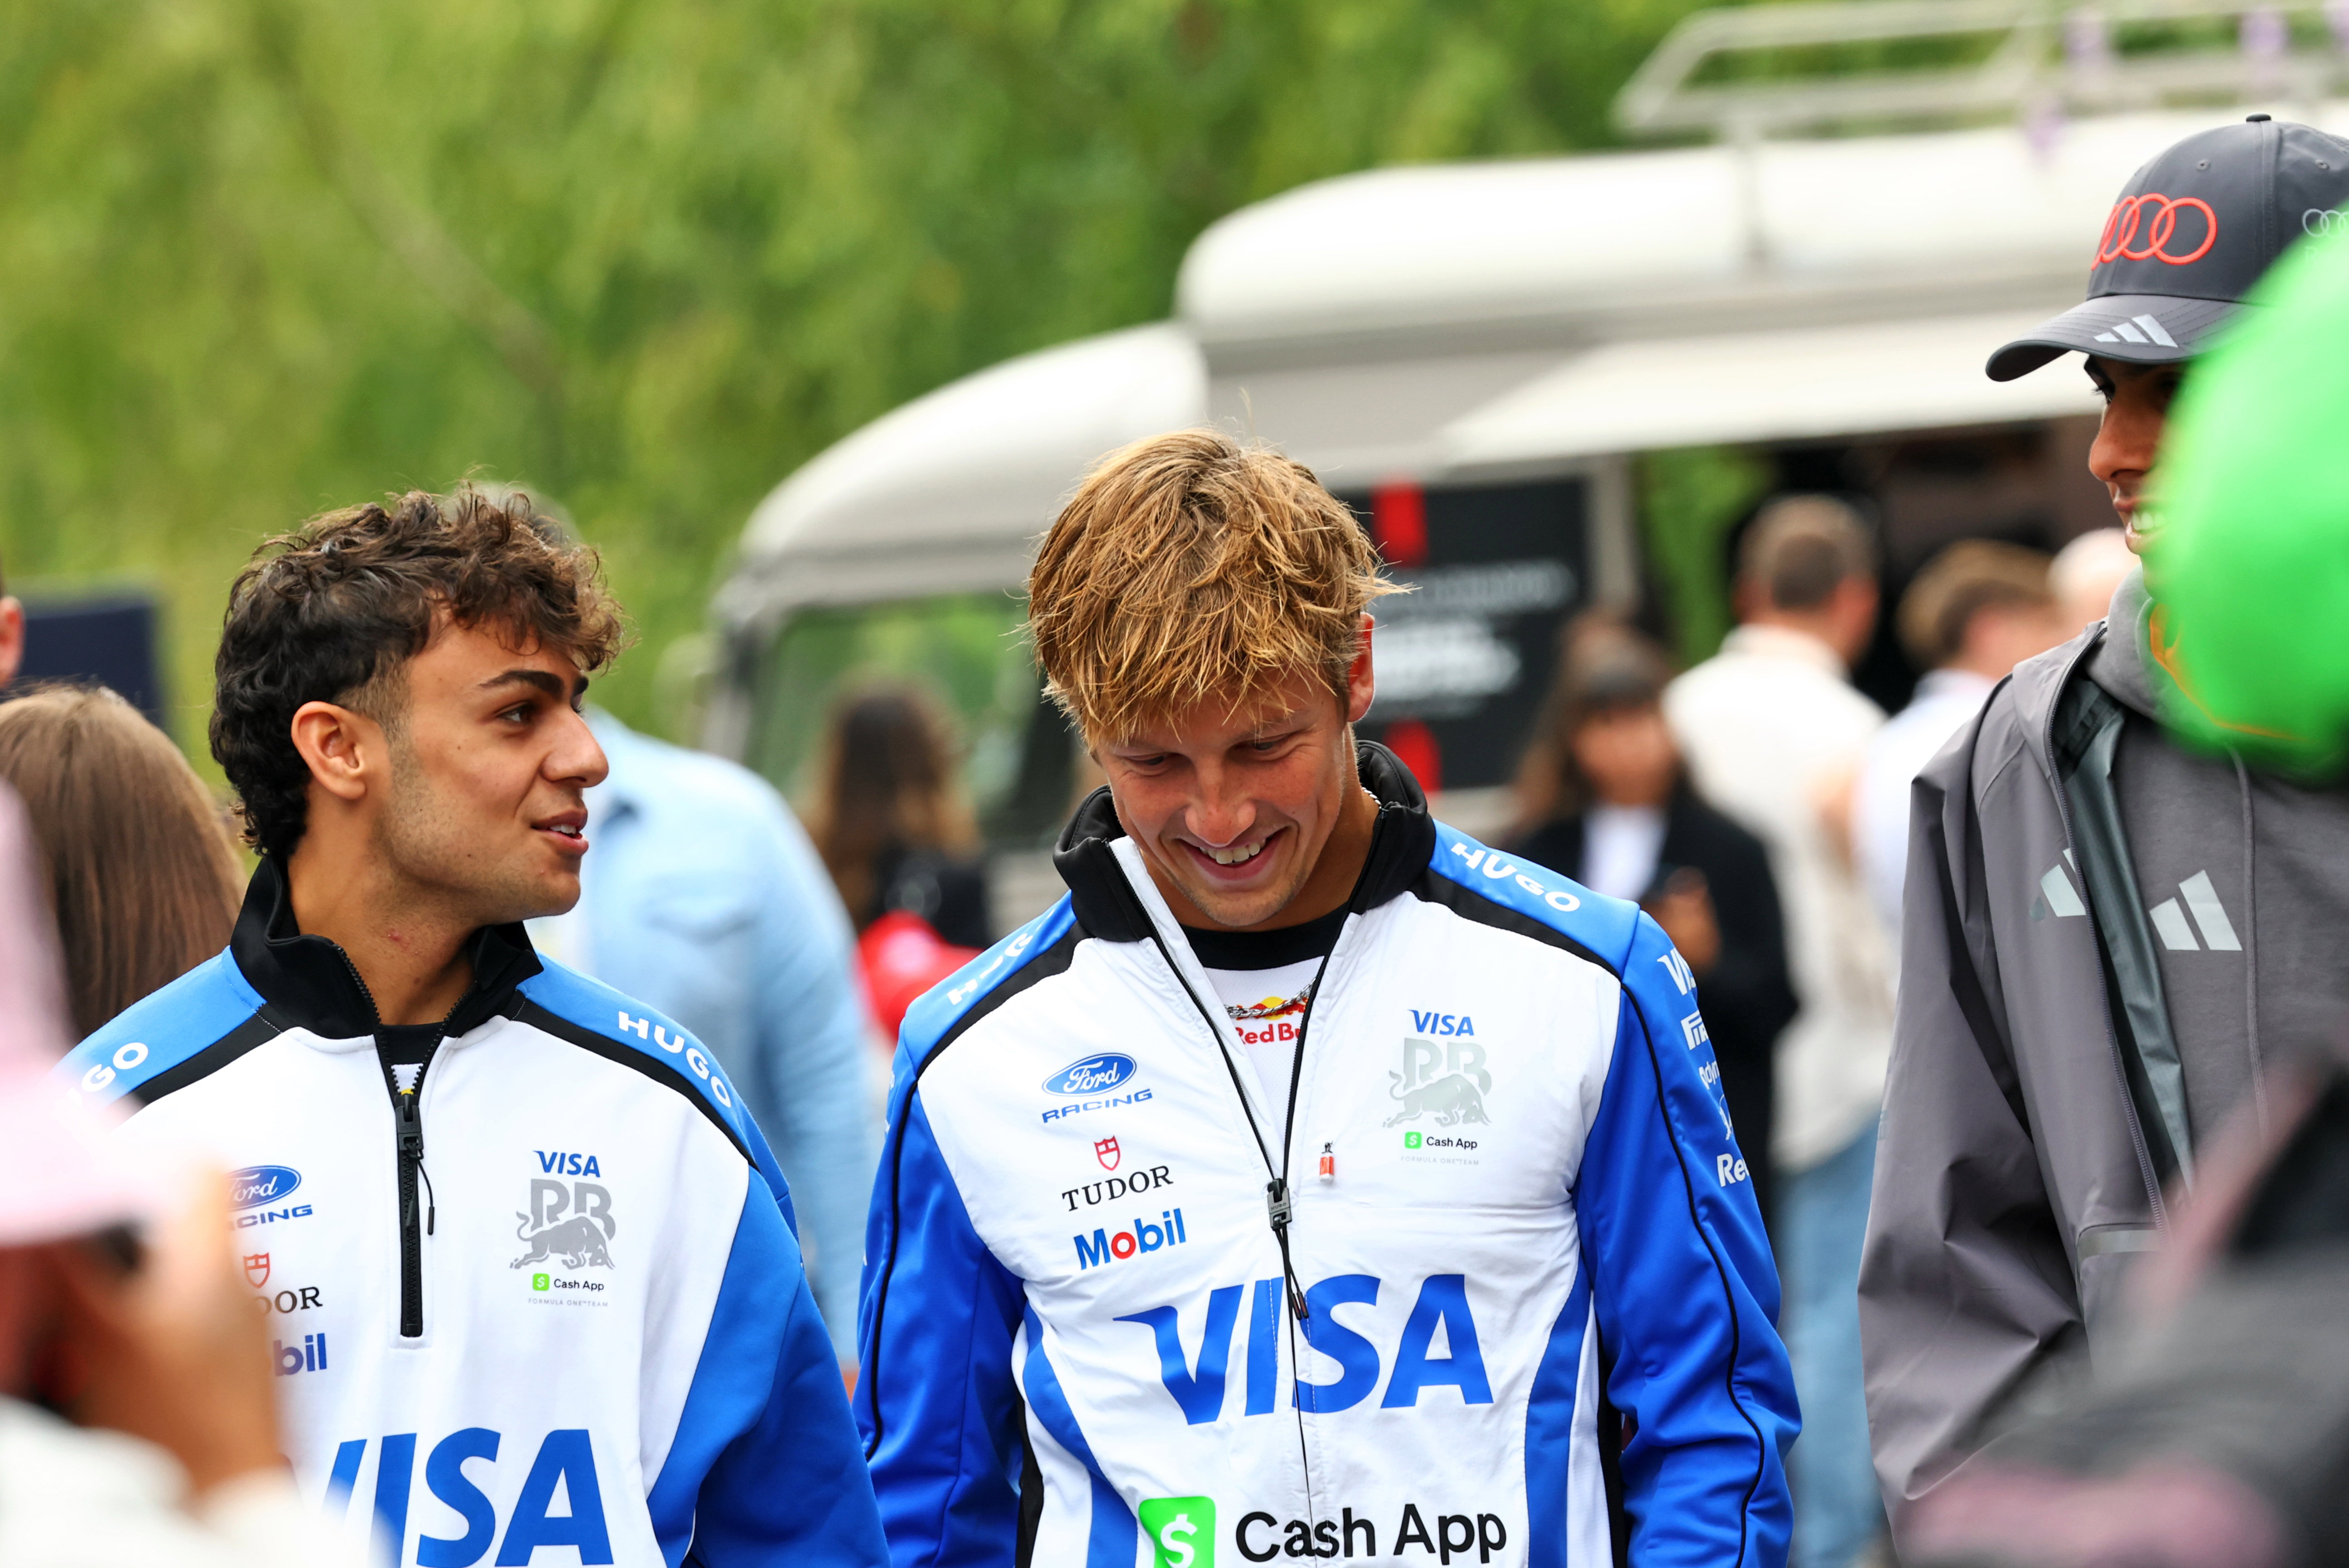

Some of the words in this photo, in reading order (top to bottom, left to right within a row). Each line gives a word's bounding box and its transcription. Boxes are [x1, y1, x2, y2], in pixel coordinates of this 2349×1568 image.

[1451, 843, 1580, 912] HUGO
[947, 907, 1056, 1005] HG
[1407, 1009, 1475, 1036] VISA
[66, 1042, 149, 1108] GO
[618, 1011, 732, 1108] HUGO
[1063, 1061, 1120, 1093] Ford
[1042, 1089, 1153, 1124] RACING
[533, 1150, 601, 1177] VISA
[1427, 1136, 1453, 1147] Cash
[1456, 1138, 1477, 1150] App
[1062, 1166, 1173, 1211] TUDOR
[227, 1204, 313, 1231] CING
[1073, 1208, 1186, 1269] Mobil
[554, 1279, 580, 1289] Cash
[583, 1281, 604, 1292] App
[273, 1333, 327, 1377] bil
[1113, 1274, 1494, 1425] VISA
[1235, 1507, 1376, 1563] Cash
[1393, 1503, 1507, 1566] App
